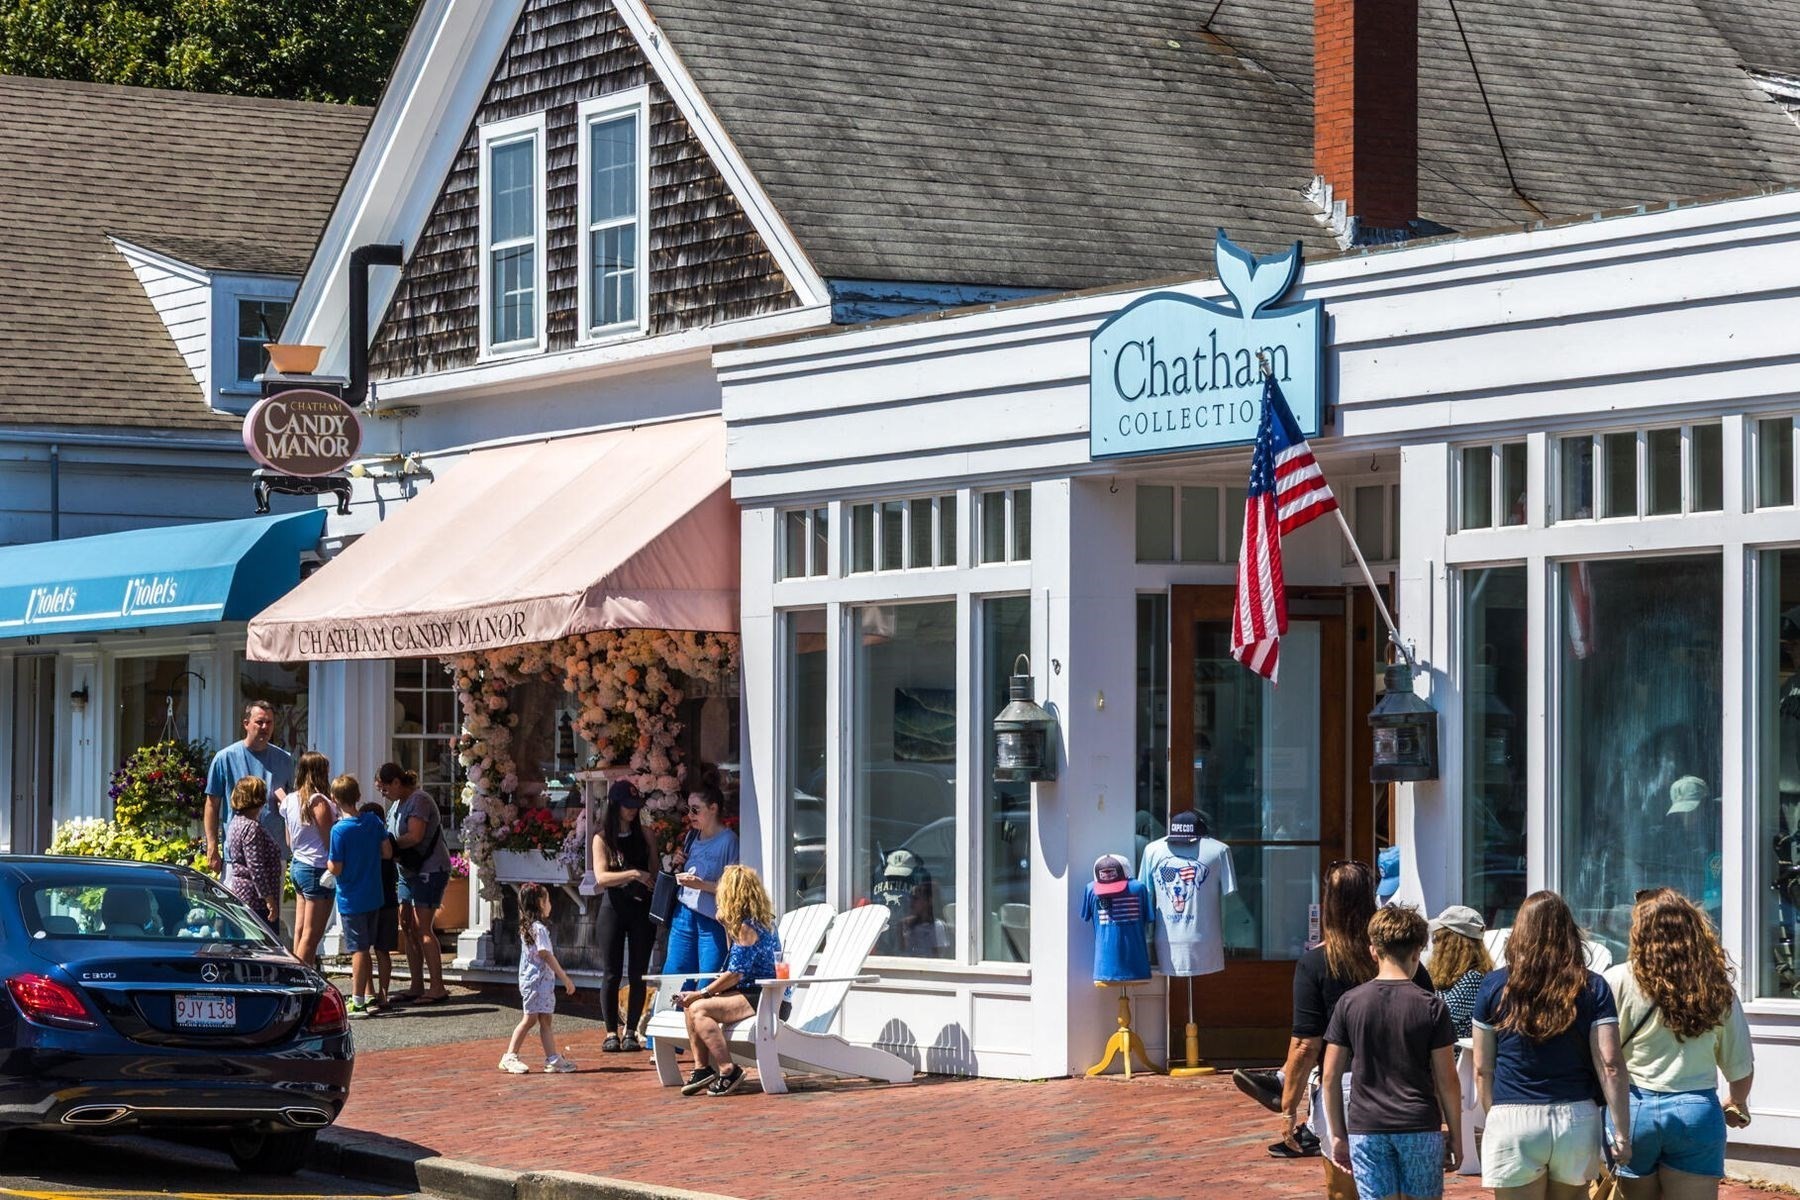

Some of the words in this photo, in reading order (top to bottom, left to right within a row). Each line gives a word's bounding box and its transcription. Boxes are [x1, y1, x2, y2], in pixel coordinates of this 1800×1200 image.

[1113, 328, 1292, 402] Chatham
[264, 402, 349, 436] CANDY
[290, 401, 342, 412] CHATHAM
[1118, 399, 1263, 437] COLLECTIO
[265, 432, 351, 459] MANOR
[25, 586, 78, 624] Violet's
[121, 576, 178, 617] Violet's
[298, 623, 388, 655] CHATHAM
[392, 621, 454, 652] CANDY
[457, 610, 527, 646] MANOR
